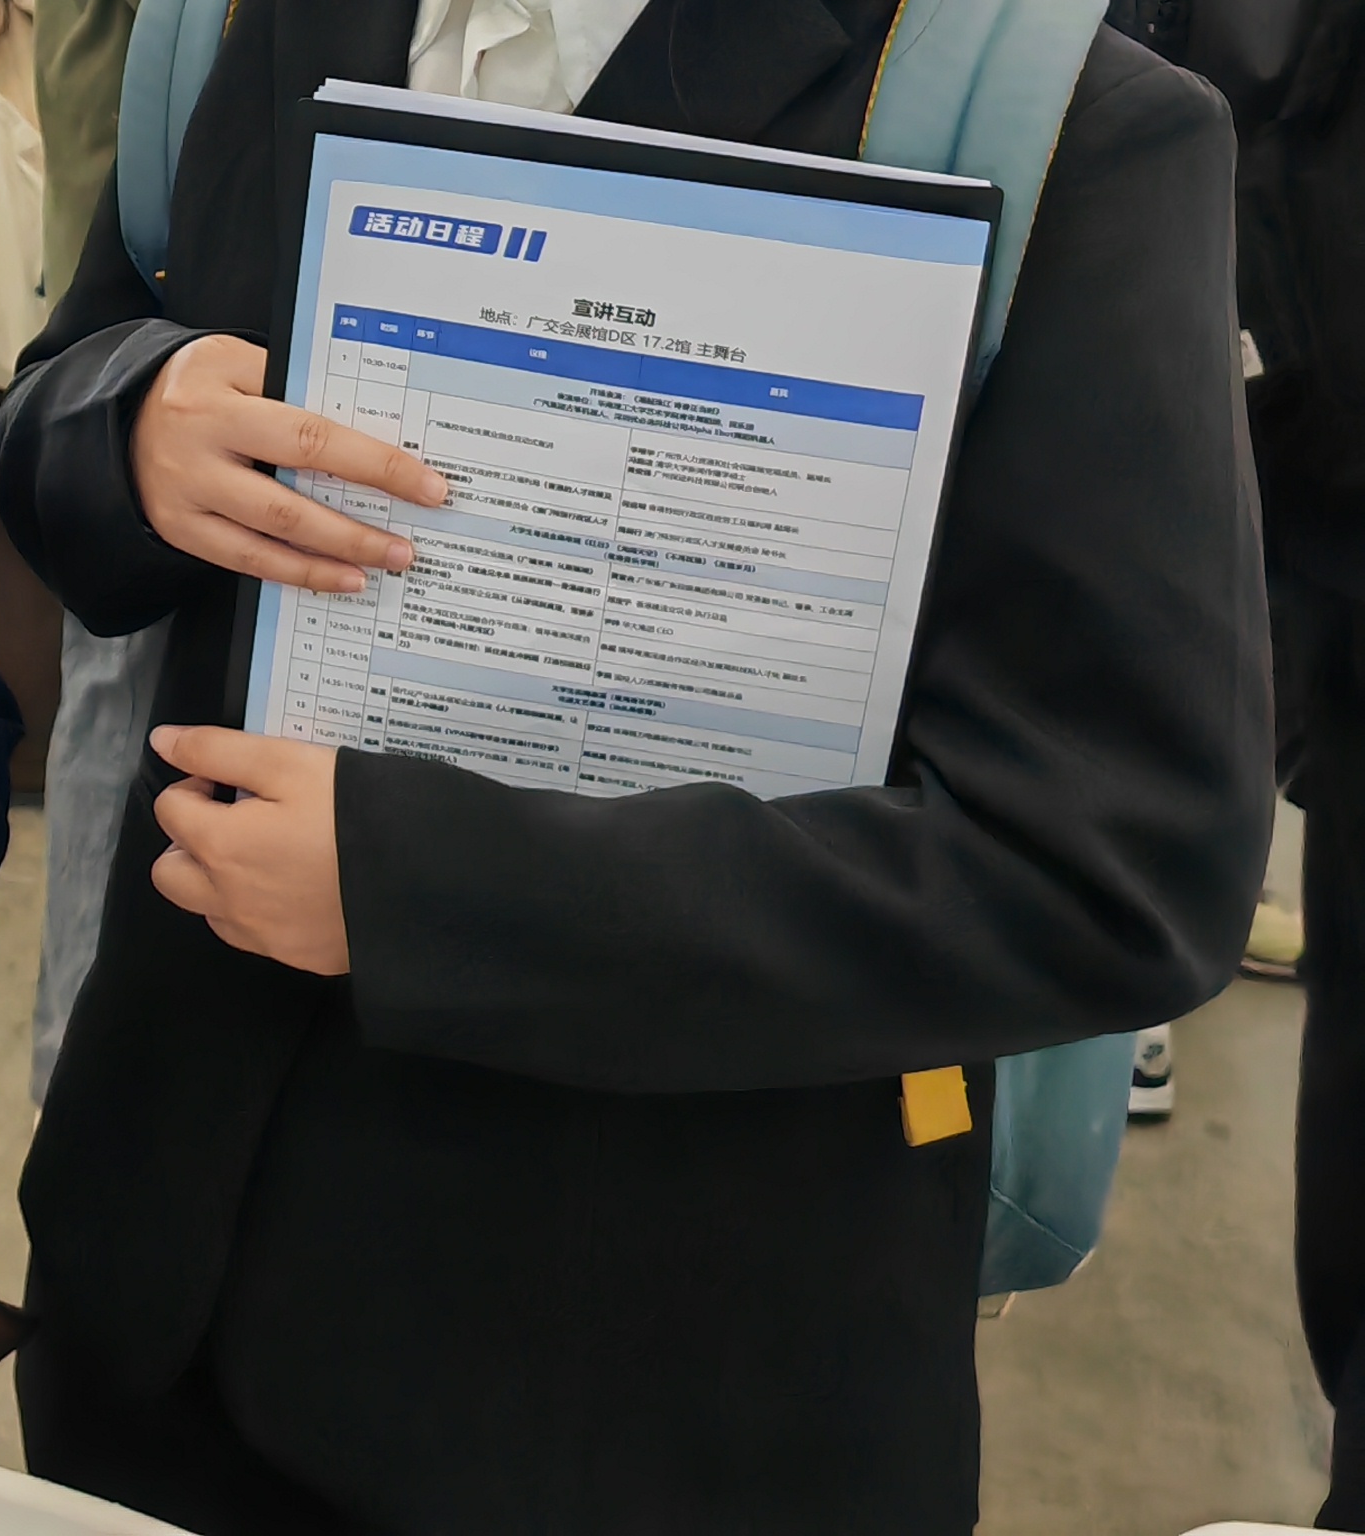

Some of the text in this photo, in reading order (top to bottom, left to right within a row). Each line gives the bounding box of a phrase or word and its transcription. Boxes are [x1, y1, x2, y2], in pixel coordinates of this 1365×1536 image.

[364, 210, 485, 248] 活动日程
[572, 297, 657, 327] 宣讲互动
[642, 333, 692, 357] 17.2馆
[696, 339, 748, 363] 主舞台
